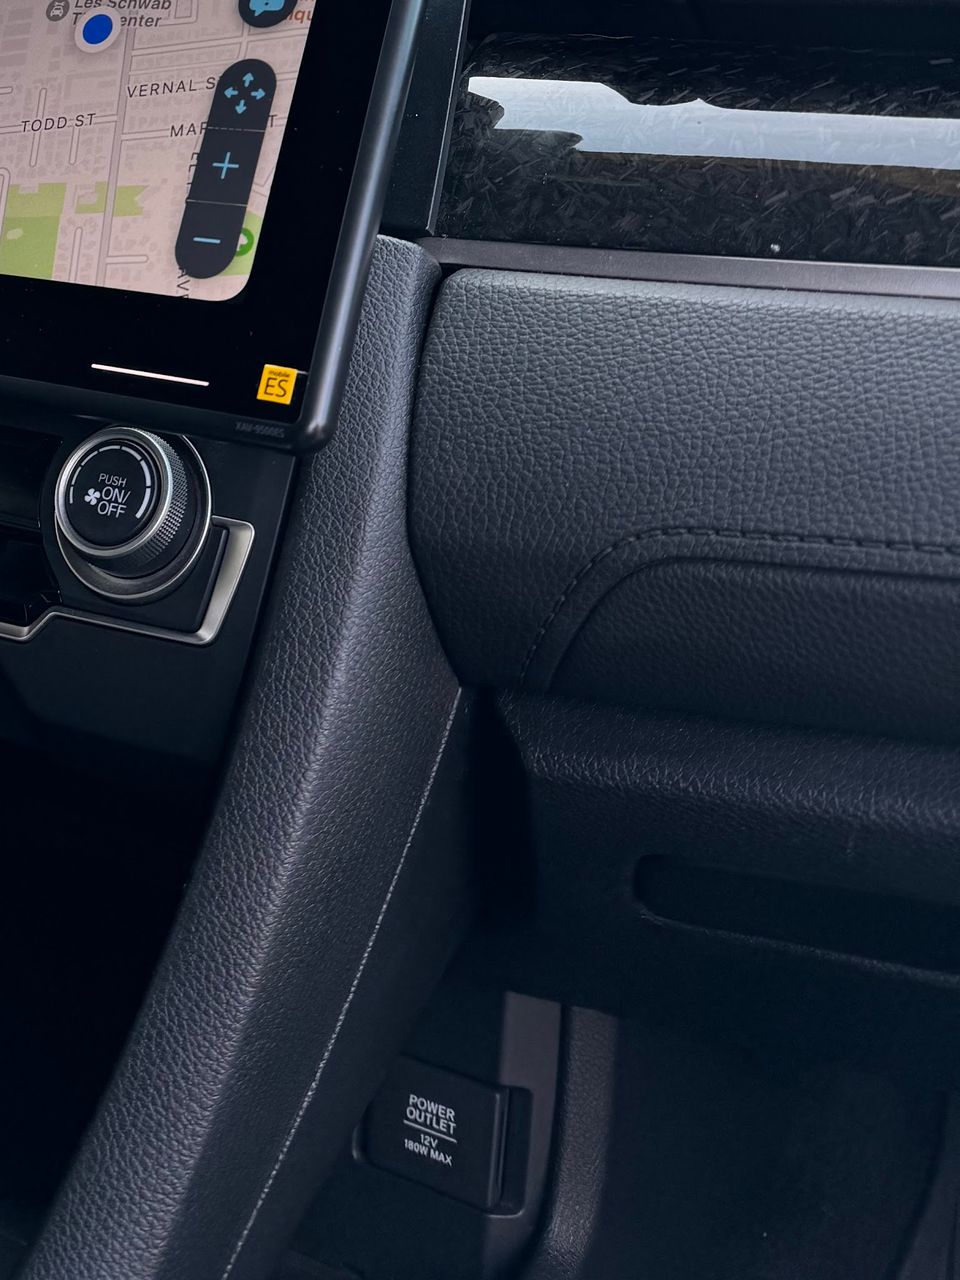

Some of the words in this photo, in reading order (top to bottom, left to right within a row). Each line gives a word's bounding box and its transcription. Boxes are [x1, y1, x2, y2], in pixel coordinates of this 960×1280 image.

[120, 14, 163, 28] enter
[127, 80, 197, 98] VERNAL
[205, 77, 216, 90] S
[21, 116, 68, 133] TODD
[75, 113, 97, 128] ST
[263, 376, 289, 398] ES
[98, 473, 127, 488] PUSH
[101, 486, 131, 504] ON/
[97, 500, 127, 518] OFF
[409, 1094, 455, 1121] POWER
[406, 1106, 457, 1135] OUTLET
[420, 1133, 438, 1148] 12V
[404, 1138, 428, 1157] 180W
[430, 1148, 453, 1167] MAX
